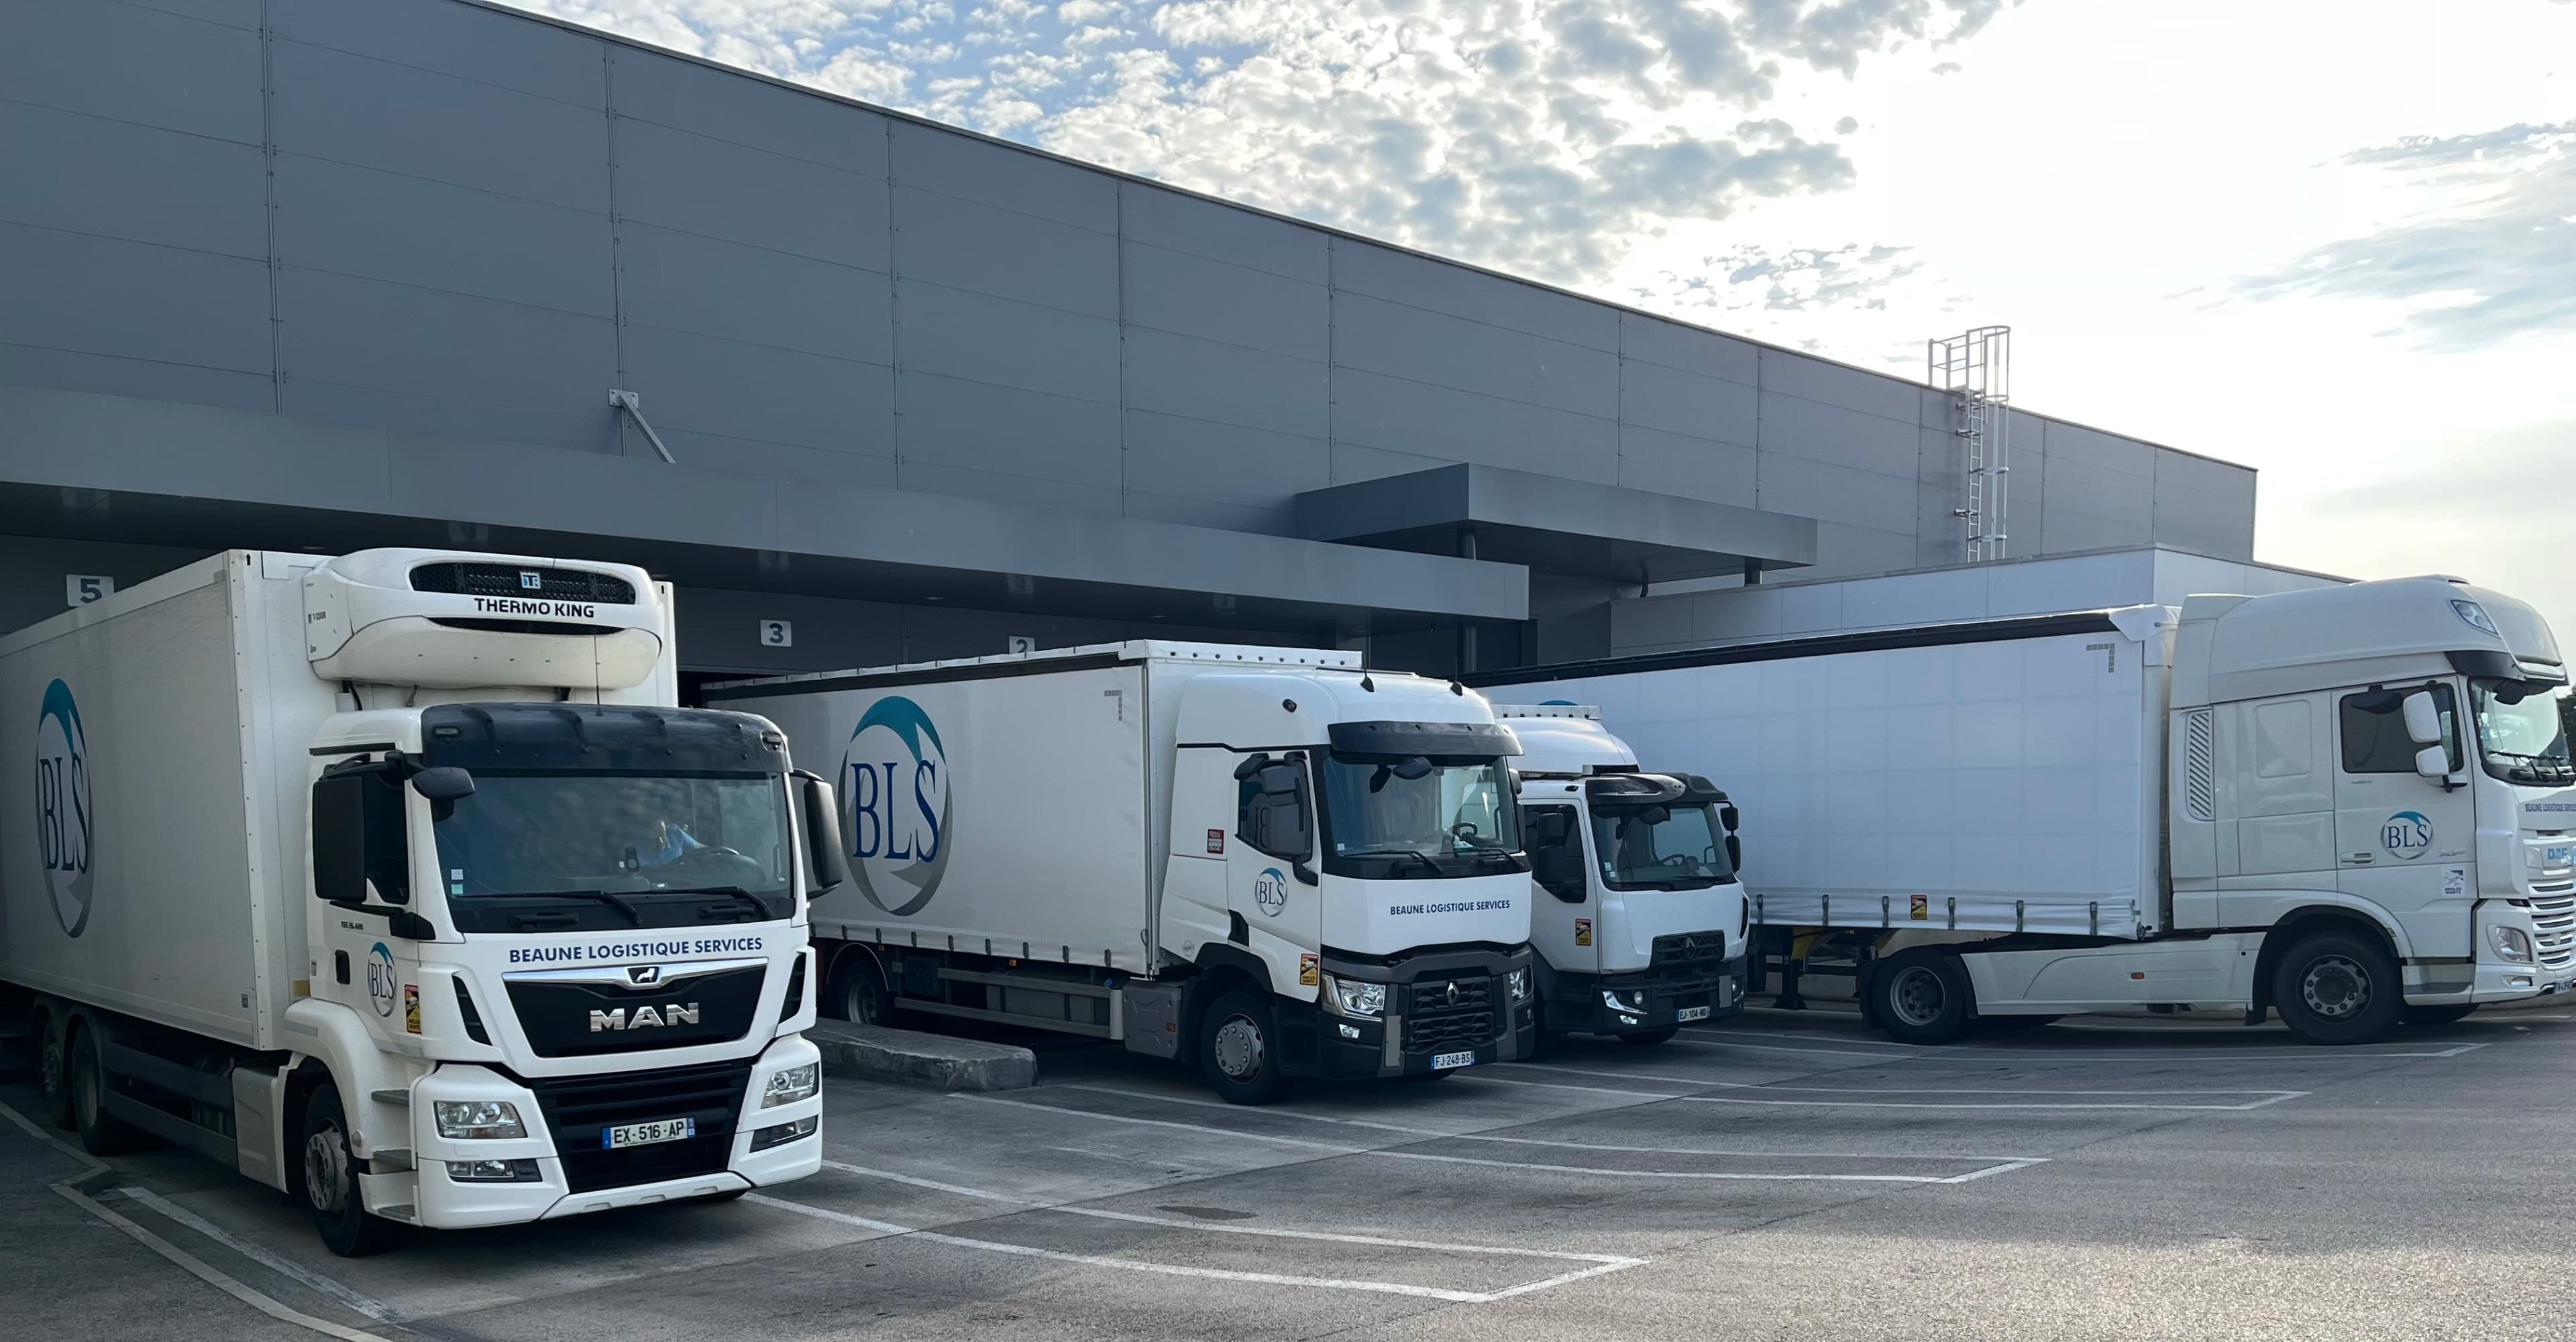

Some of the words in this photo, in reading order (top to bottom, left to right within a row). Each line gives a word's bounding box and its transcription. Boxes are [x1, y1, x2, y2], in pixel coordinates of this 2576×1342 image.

[80, 578, 102, 603] 5
[474, 598, 550, 615] THERMO
[555, 603, 594, 618] KING
[769, 622, 784, 644] 3
[40, 752, 88, 875] BLS
[851, 759, 939, 863] BLS
[2387, 824, 2427, 848] BLS
[1259, 881, 1284, 905] BLS
[1391, 905, 1424, 915] BEAUNE
[1426, 901, 1474, 913] LOGISTIQUE
[1477, 900, 1510, 911] SERVICES
[509, 946, 582, 963] BEAUNE
[588, 942, 689, 959] LOGISTIQUE
[695, 937, 763, 953] SERVICES
[370, 962, 394, 999] BLS
[590, 1002, 699, 1032] MAN
[1436, 1053, 1470, 1067] FJ-248-BS
[614, 1121, 684, 1144] EX-516-AP
